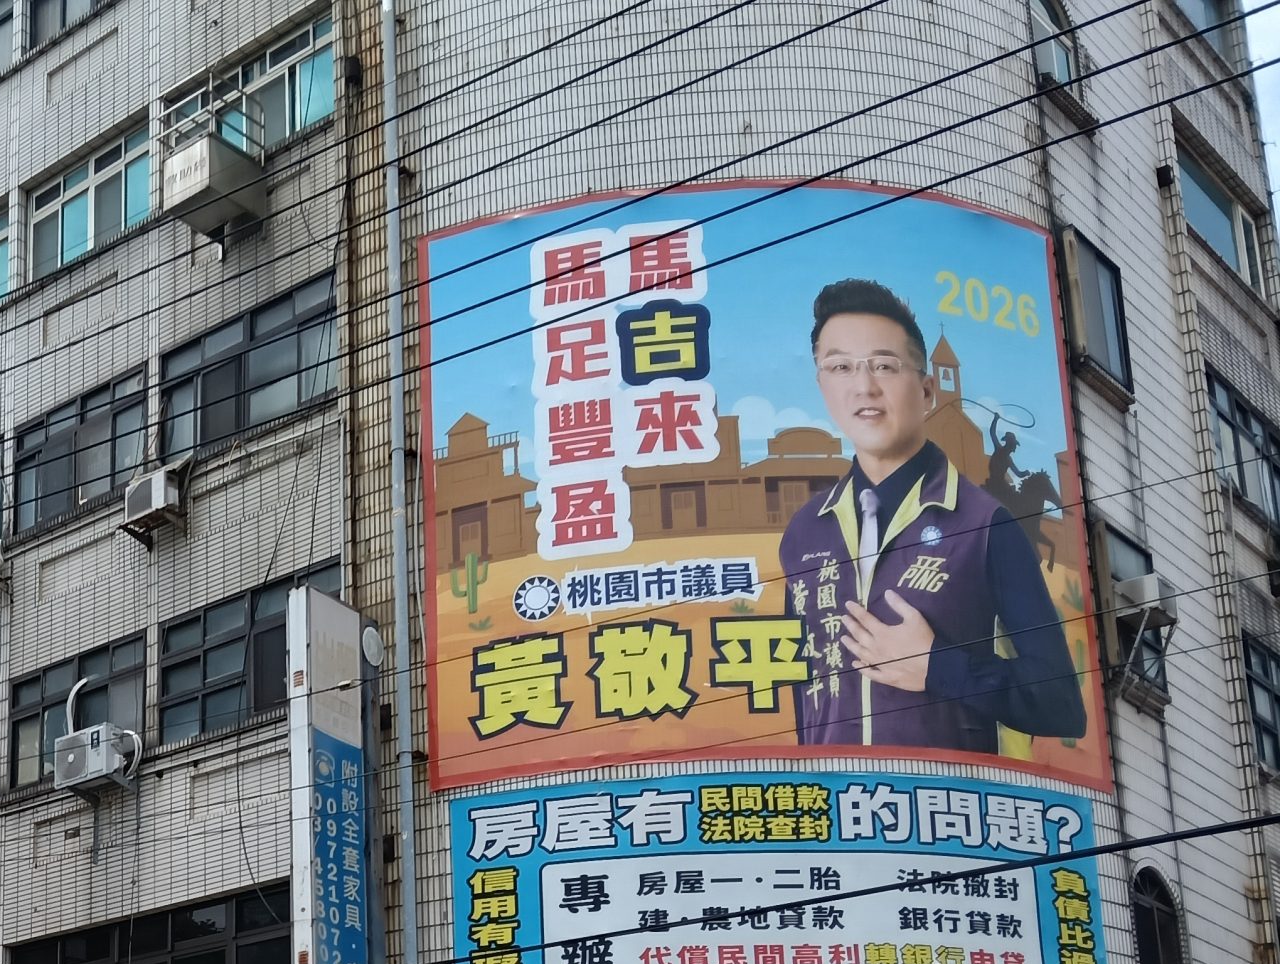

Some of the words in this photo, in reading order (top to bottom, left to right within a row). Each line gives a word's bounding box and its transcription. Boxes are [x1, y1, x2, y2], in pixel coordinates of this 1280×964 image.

[935, 270, 1041, 337] 2026
[628, 230, 705, 455] 馬吉來
[542, 240, 618, 547] 馬足豐盈
[565, 562, 756, 609] 桃園市議員
[897, 563, 951, 593] PING
[816, 557, 844, 698] 桃園市議員
[470, 618, 810, 738] 黃敬平
[468, 789, 694, 861] 房屋有
[701, 784, 829, 813] 民間借款
[701, 813, 830, 842] 法院查封
[838, 782, 1082, 856] 的問題?
[897, 868, 1020, 902] 法院撤封
[898, 906, 1024, 940] 銀行貸款
